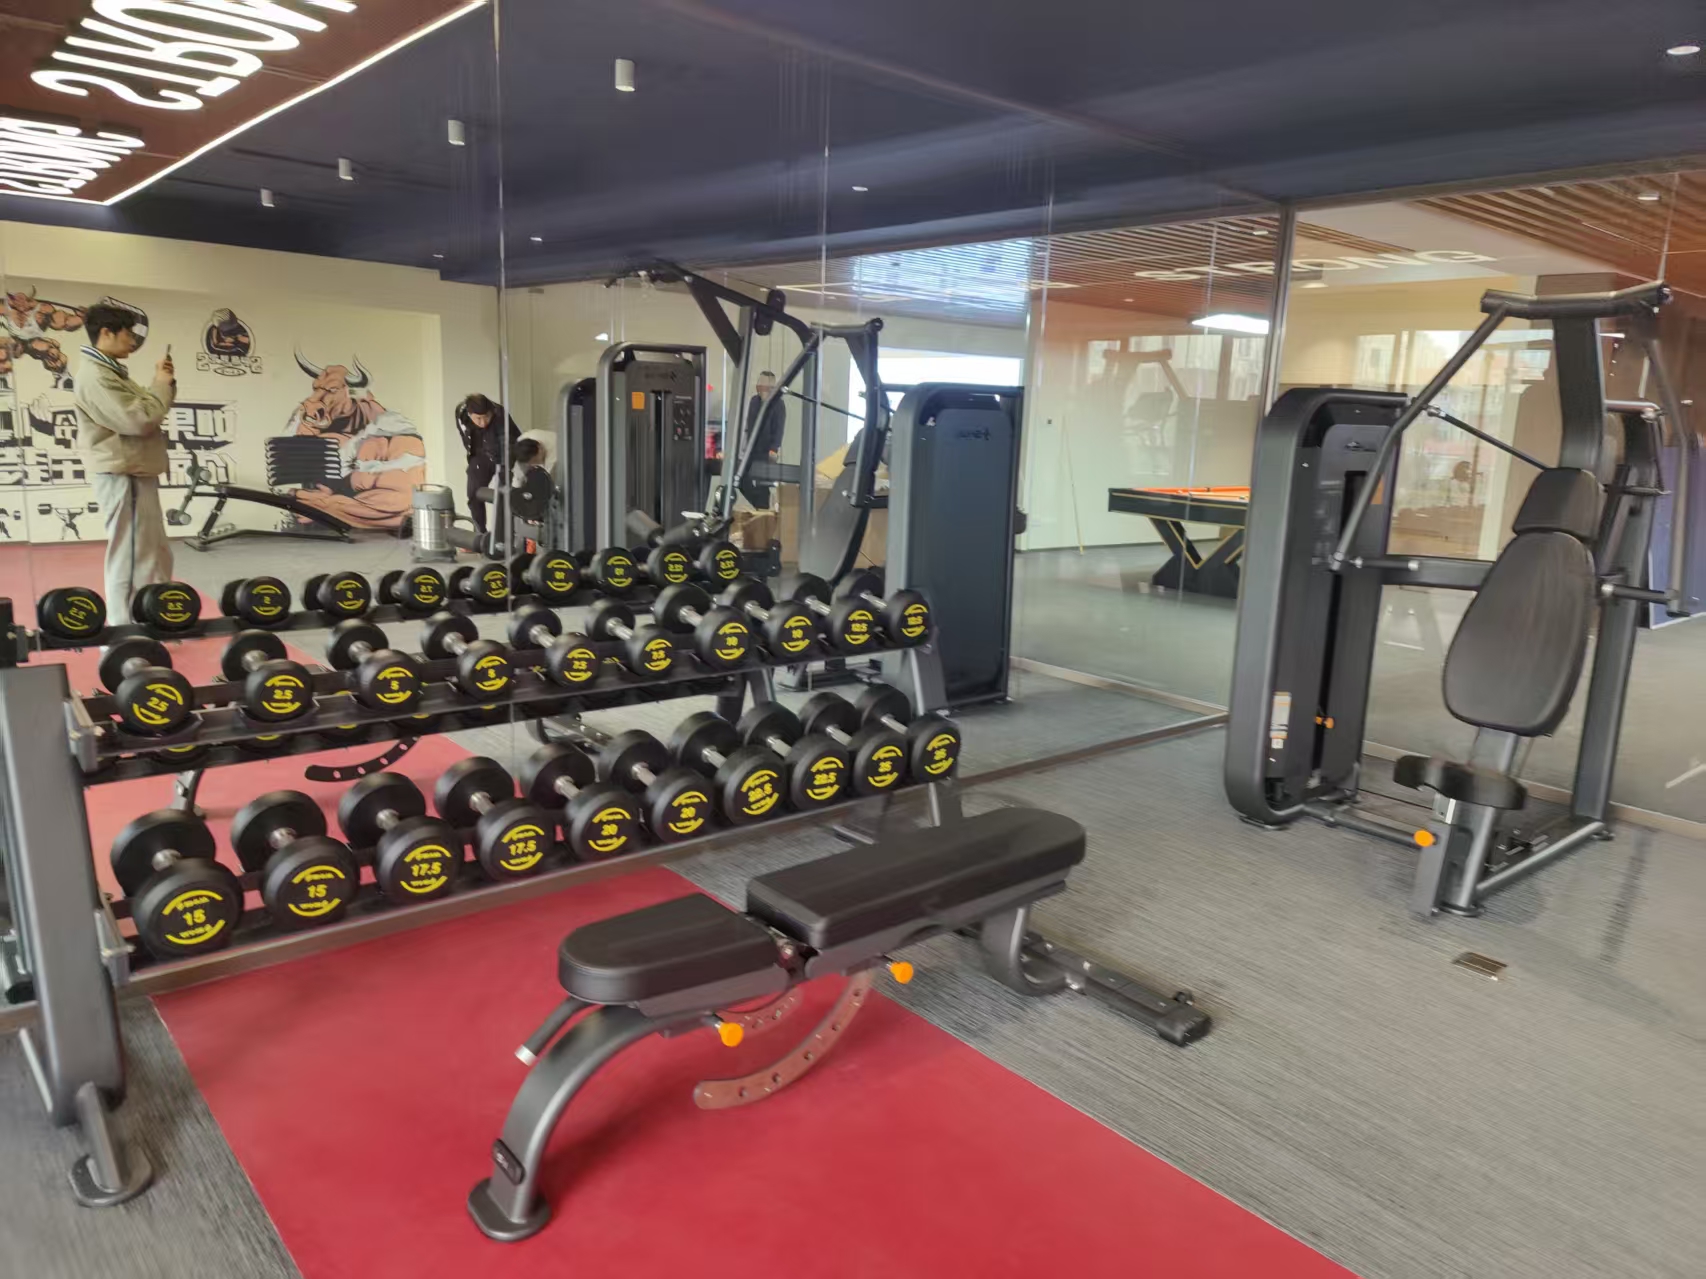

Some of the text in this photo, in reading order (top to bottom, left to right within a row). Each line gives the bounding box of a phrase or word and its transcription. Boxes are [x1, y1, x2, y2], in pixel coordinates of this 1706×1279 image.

[1134, 249, 1496, 282] STRONG
[391, 680, 399, 690] 5
[601, 824, 618, 836] 20
[509, 840, 536, 856] 17.5
[411, 862, 442, 877] 17.5
[308, 885, 327, 898] 15
[183, 909, 206, 926] 15
